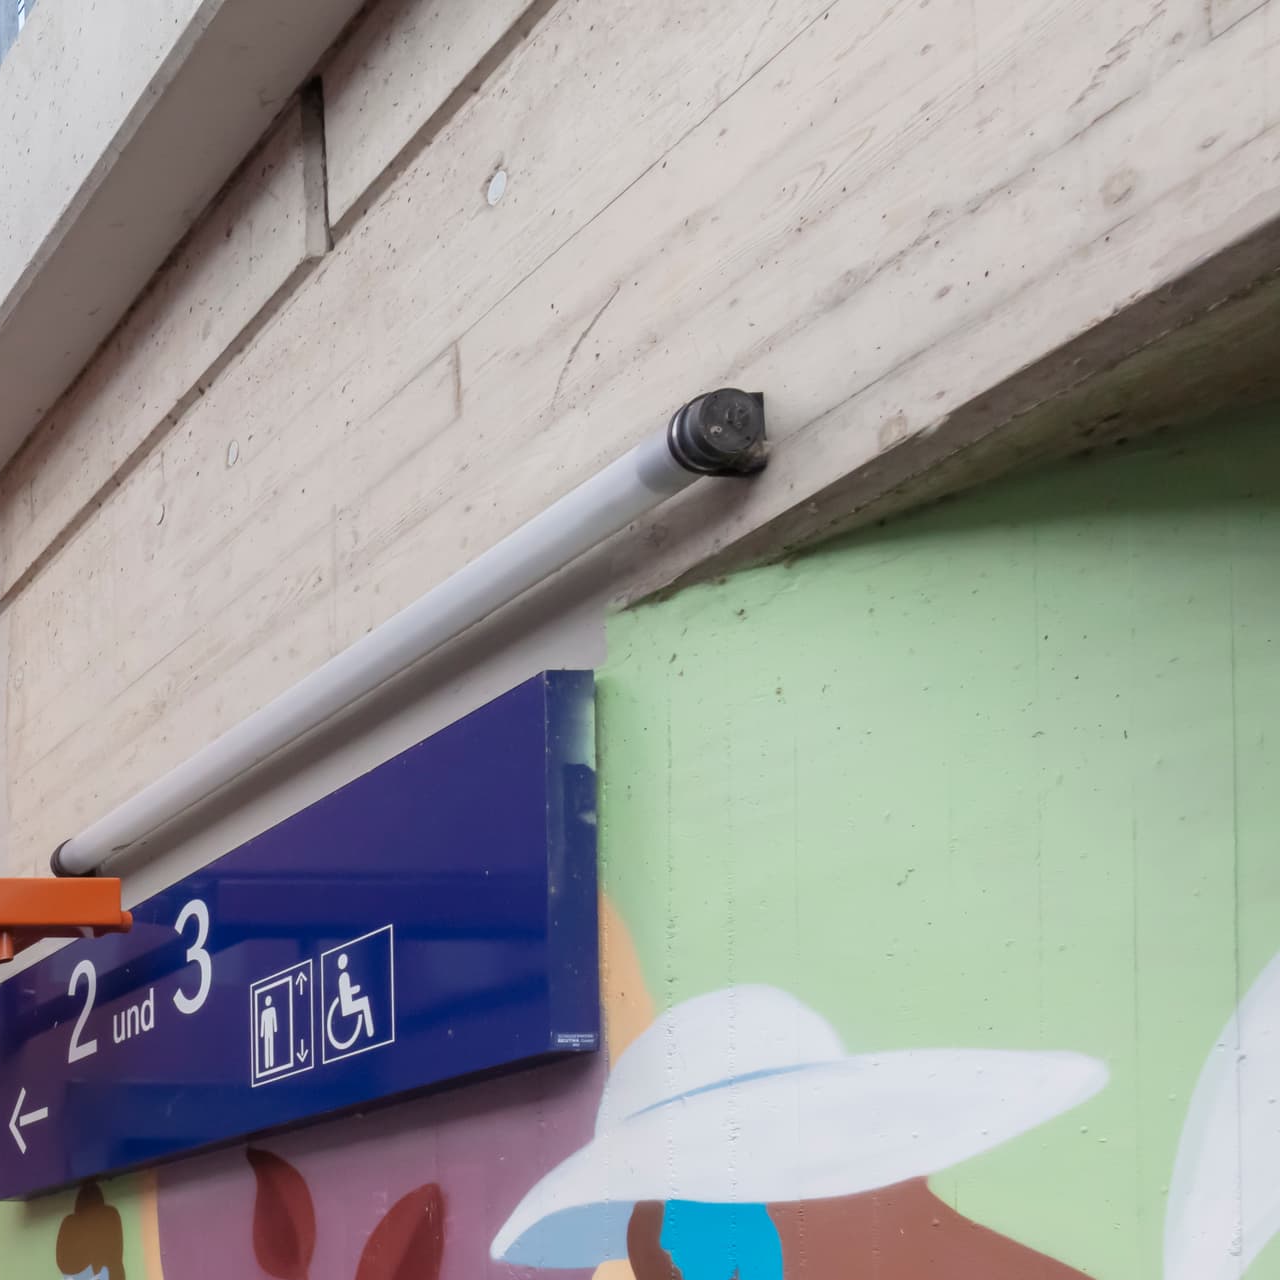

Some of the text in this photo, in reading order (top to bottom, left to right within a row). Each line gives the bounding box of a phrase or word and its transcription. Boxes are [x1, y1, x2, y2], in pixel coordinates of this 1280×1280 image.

[67, 898, 213, 1064] 2 und 3
